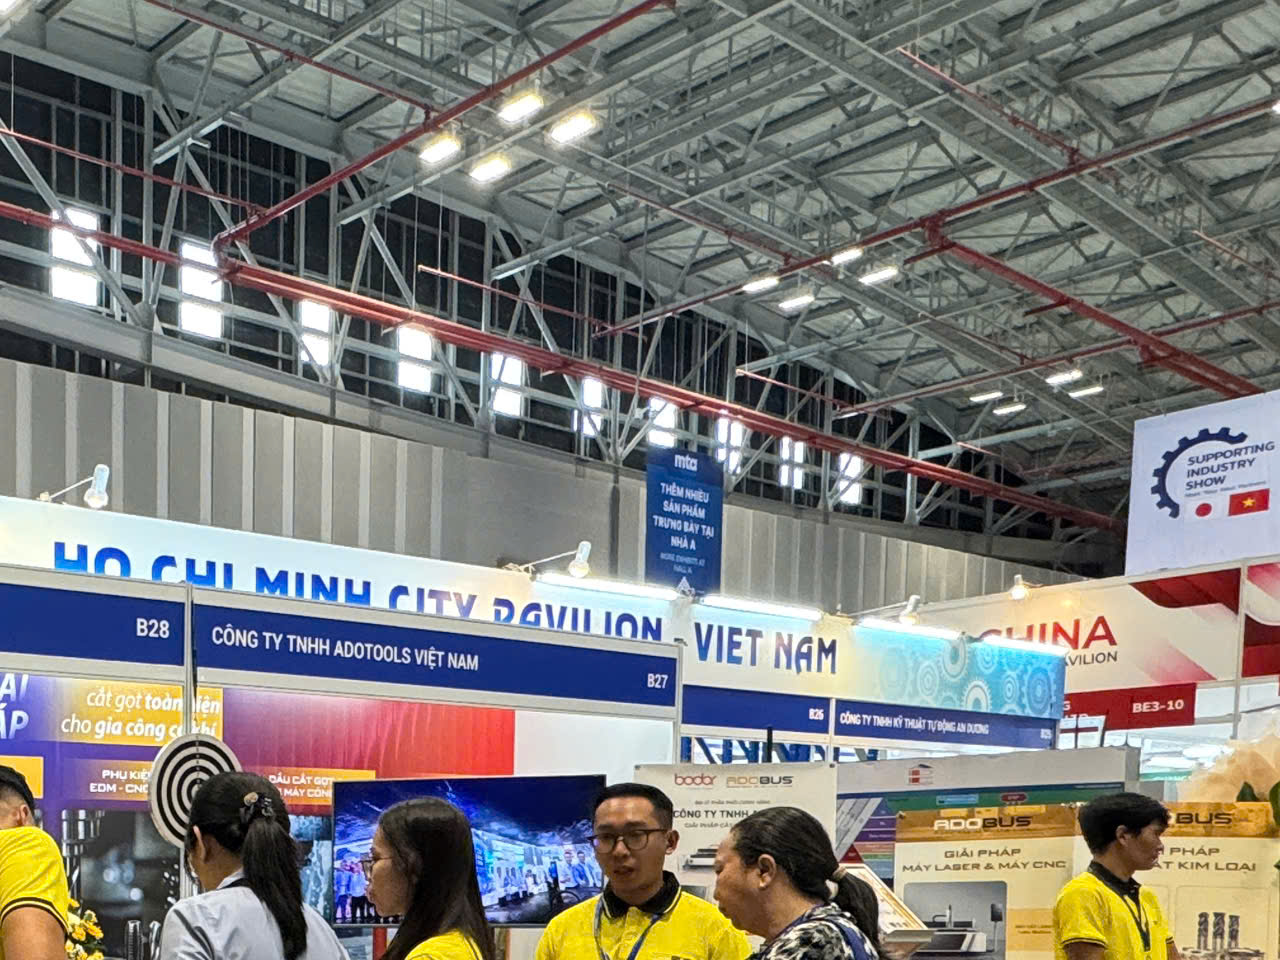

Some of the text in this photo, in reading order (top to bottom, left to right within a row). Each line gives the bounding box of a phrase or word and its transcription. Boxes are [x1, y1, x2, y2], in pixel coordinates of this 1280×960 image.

[1187, 440, 1275, 466] SUPPORTING
[675, 454, 698, 471] mta
[1186, 457, 1256, 478] INDUSTRY
[1185, 475, 1226, 491] SHOW
[690, 540, 696, 550] A
[136, 618, 170, 639] B28
[212, 624, 479, 671] CÔNG TY TNHH ADOTOOLS VIỆT NAM
[694, 622, 763, 667] VIET
[774, 631, 837, 674] NAM
[647, 673, 669, 689] B27
[191, 695, 220, 718] iện
[1132, 699, 1184, 713] BE3-10
[61, 713, 92, 733] cho
[95, 717, 123, 738] gia
[125, 718, 165, 742] công
[862, 714, 871, 726] TY
[101, 769, 127, 783] PHỤ
[726, 775, 794, 785] ADOBUS
[89, 782, 117, 793] EDM
[704, 810, 718, 818] TY
[933, 816, 1033, 832] ADOBUS
[944, 845, 1021, 859] GIẢI PHÁP
[1169, 845, 1220, 856] PHÁP
[902, 861, 932, 873] MÁY
[934, 863, 981, 872] LASER
[998, 858, 1030, 870] MÁY
[1032, 860, 1067, 869] CNC
[1177, 861, 1210, 871] KIM
[1214, 862, 1257, 874] LOẠI
